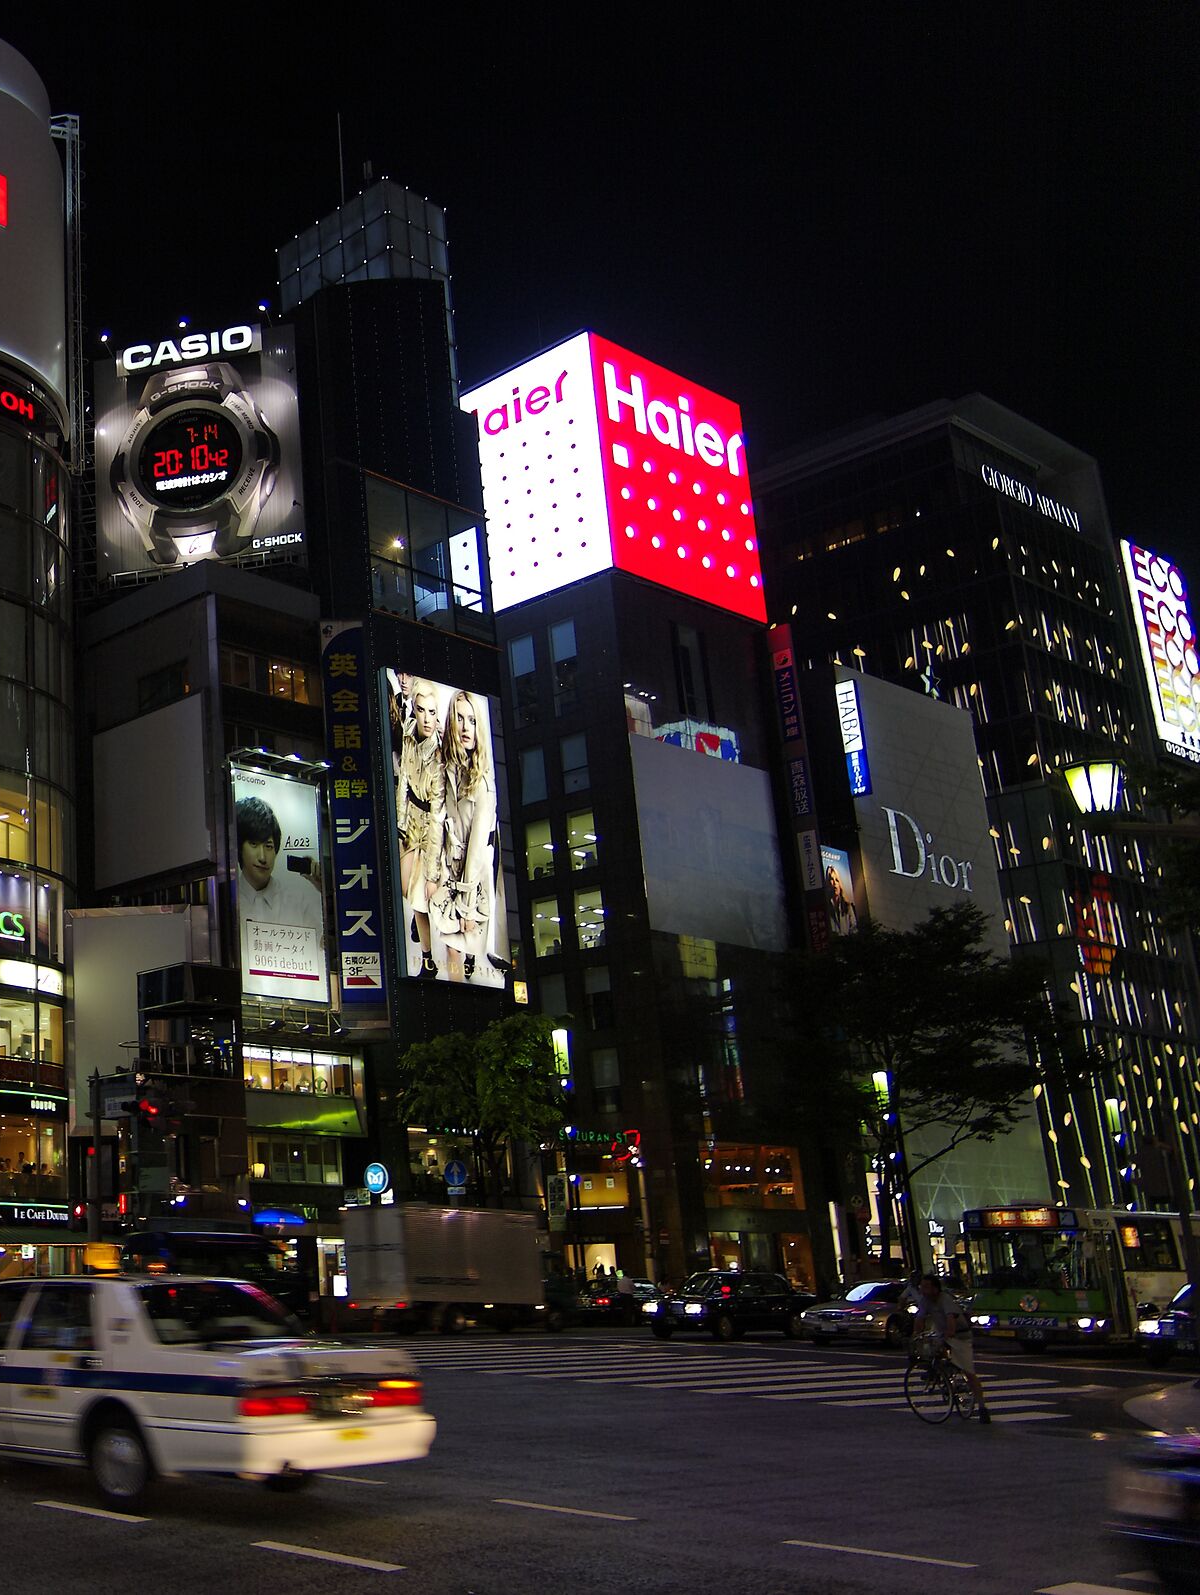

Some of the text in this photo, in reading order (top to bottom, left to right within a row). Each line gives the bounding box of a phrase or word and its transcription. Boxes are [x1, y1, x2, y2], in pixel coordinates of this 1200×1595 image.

[122, 326, 253, 371] CASIO
[150, 381, 221, 402] G-SHOCK
[482, 370, 568, 436] aier
[603, 361, 743, 477] Haier
[238, 467, 256, 496] RECEIVE
[128, 490, 145, 510] MODE
[981, 463, 1082, 533] GIORGIO ARMANI
[252, 532, 303, 549] G-SHOCK
[838, 689, 861, 746] HABA
[236, 773, 266, 786] docomo
[880, 806, 973, 893] Dior
[335, 817, 377, 939] ジオス
[252, 926, 311, 942] オールラウンド
[253, 940, 306, 956] 動画ケータイ
[348, 967, 363, 976] 3F
